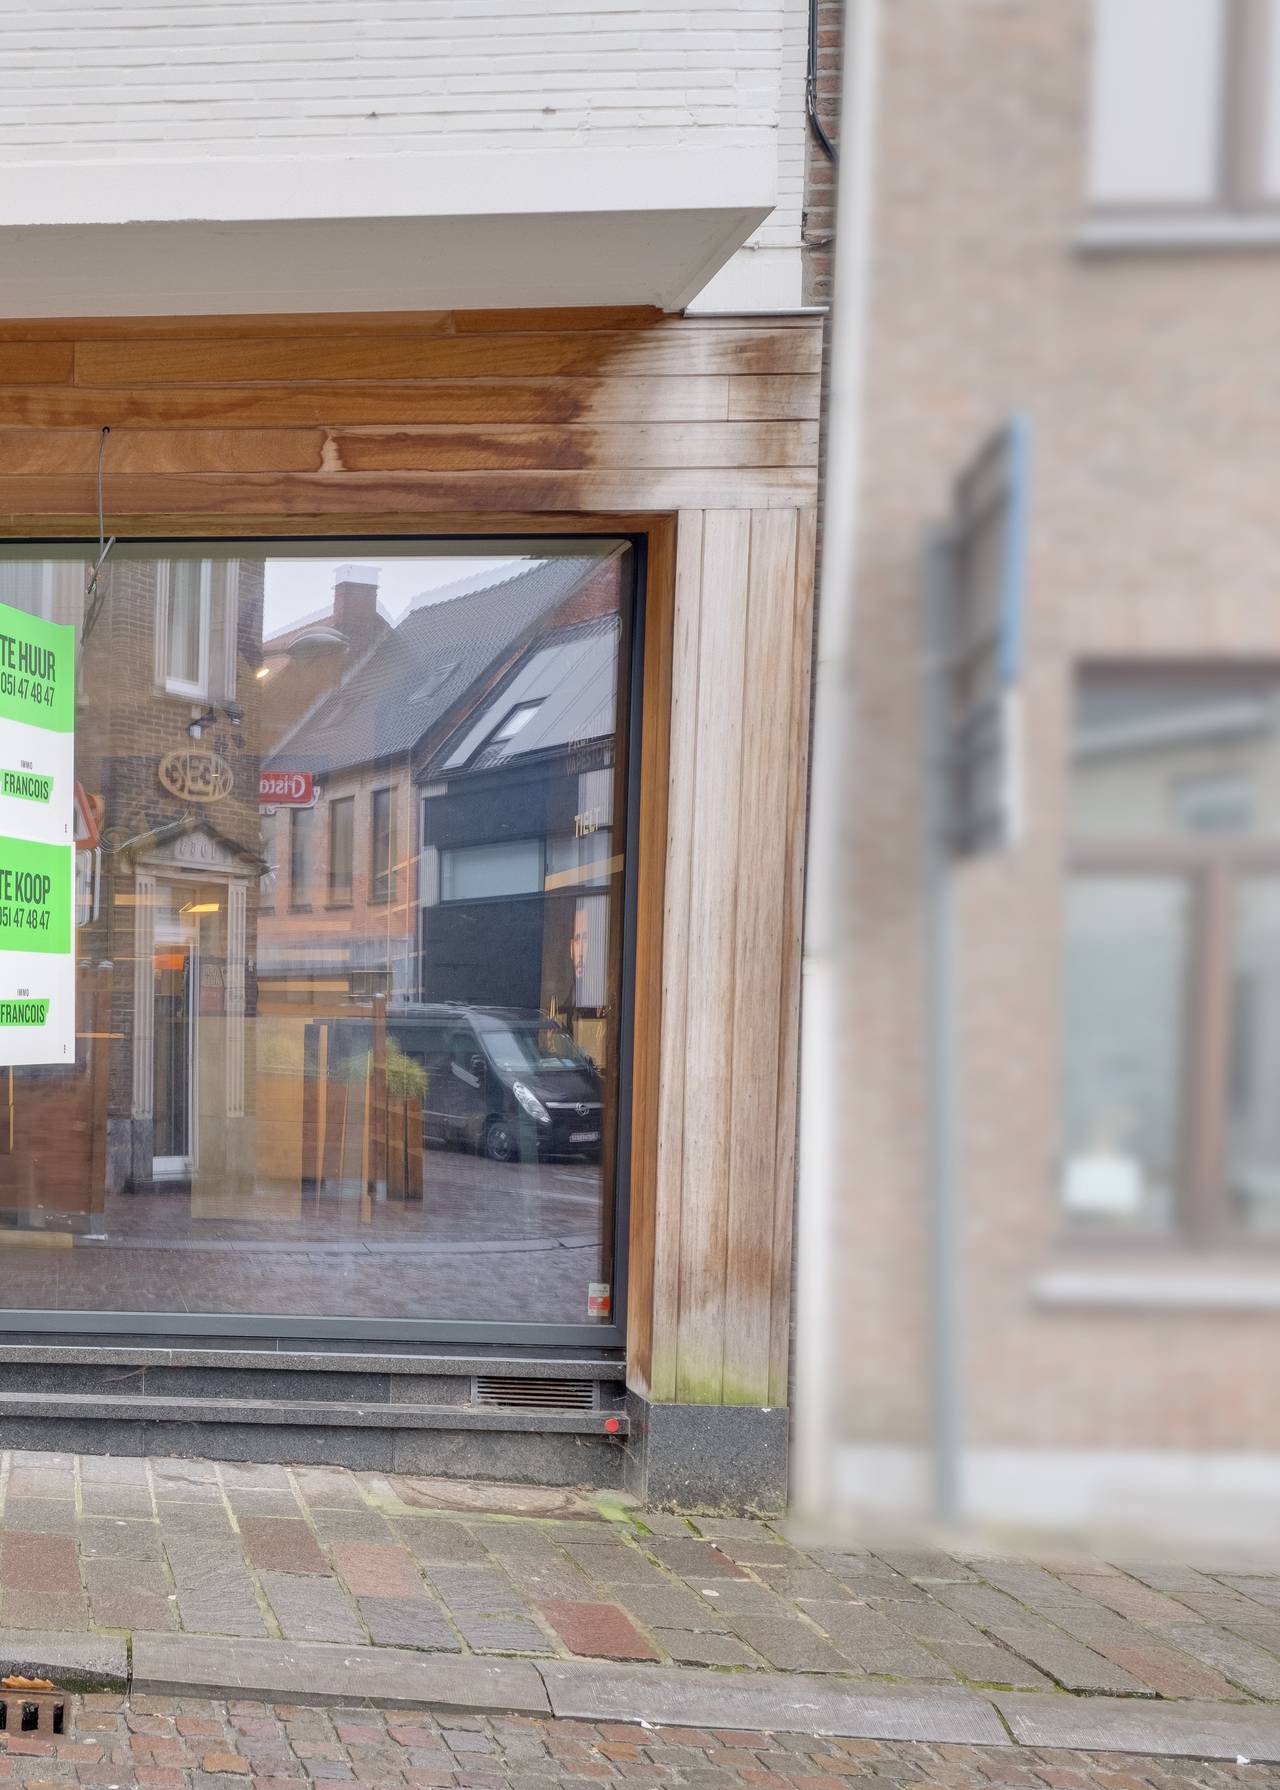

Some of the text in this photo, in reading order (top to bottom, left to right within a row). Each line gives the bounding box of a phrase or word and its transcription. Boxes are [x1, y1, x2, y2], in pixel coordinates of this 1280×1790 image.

[0, 633, 57, 683] TE HUUR
[0, 671, 55, 708] 051 47 48 47
[4, 773, 49, 800] FRANCOIS
[15, 872, 51, 905] KOOP
[13, 908, 24, 928] 47
[26, 909, 38, 930] 48
[40, 911, 50, 930] 47
[0, 1004, 45, 1023] FRANCOIS
